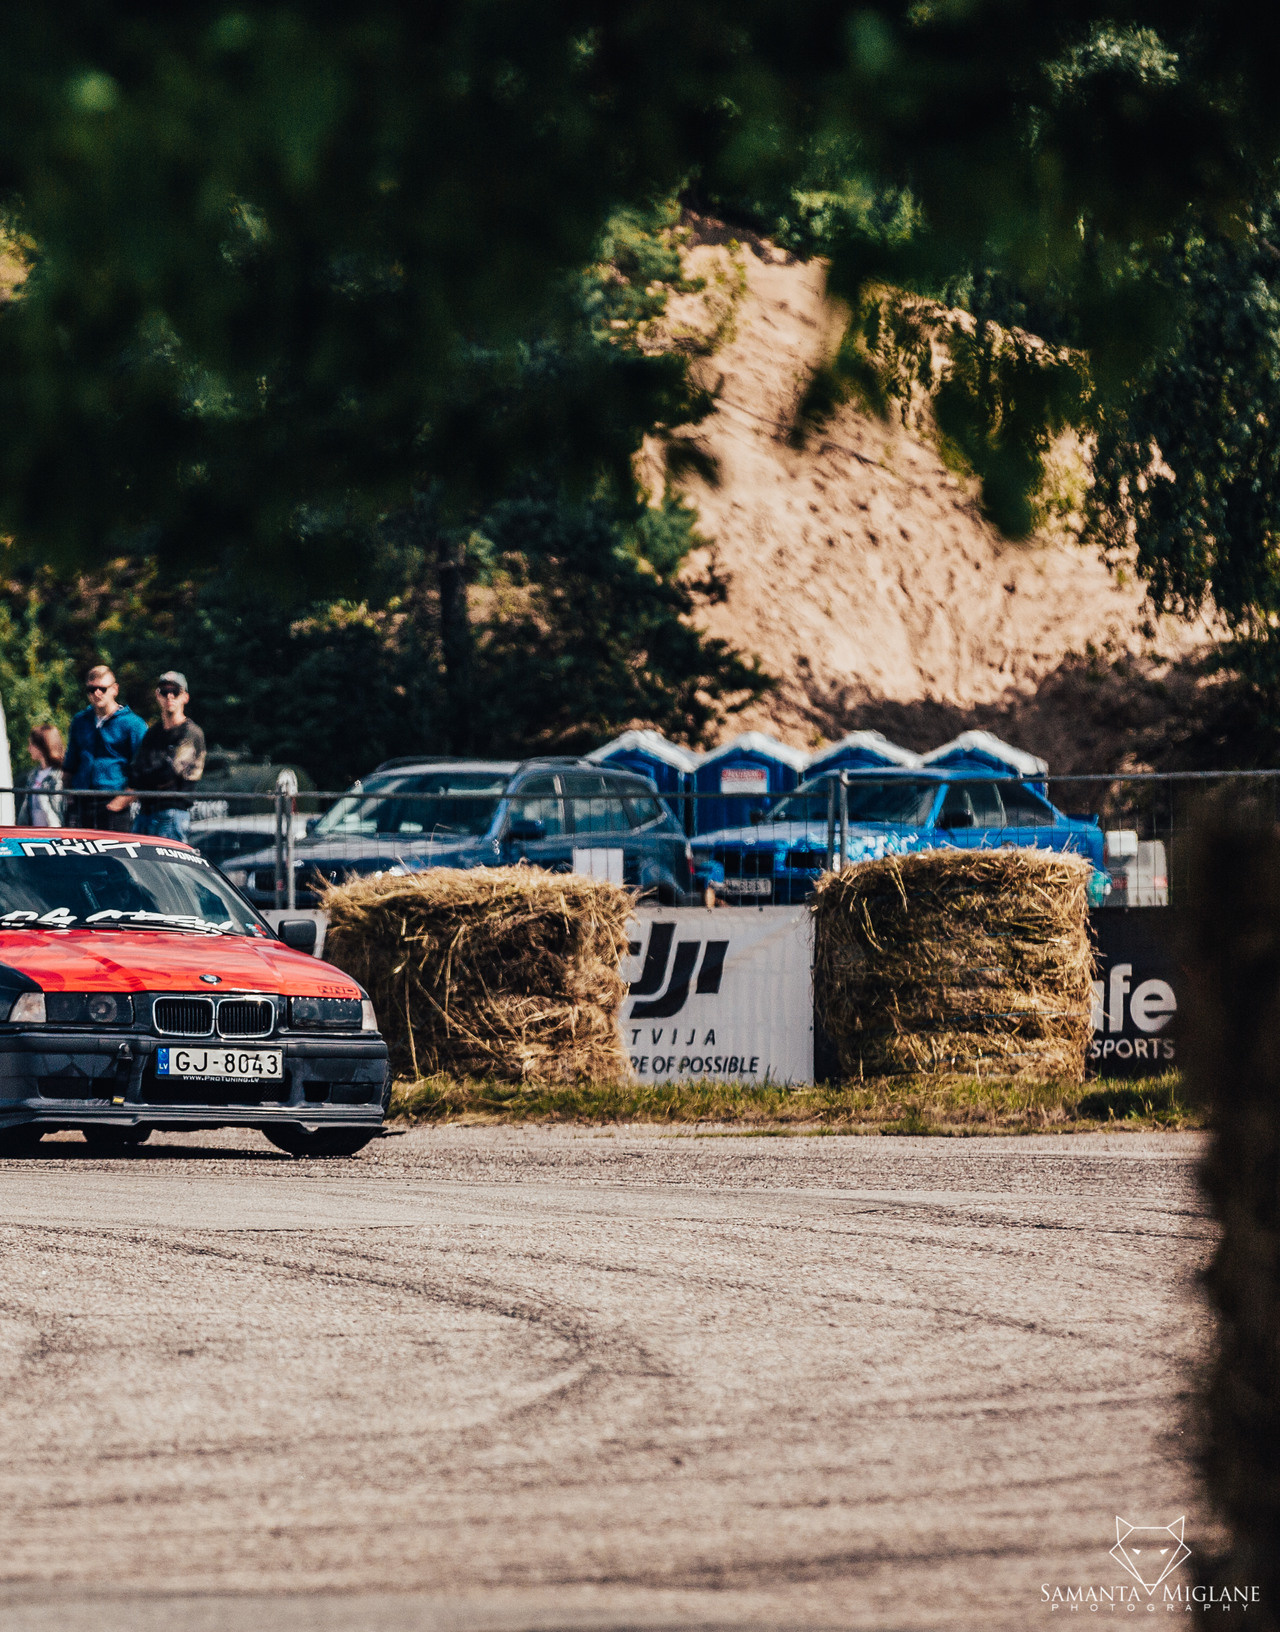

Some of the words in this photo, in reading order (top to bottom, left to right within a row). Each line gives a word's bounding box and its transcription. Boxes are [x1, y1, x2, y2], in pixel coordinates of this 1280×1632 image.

[155, 847, 210, 867] #LVDRIFT
[1090, 1038, 1176, 1059] SPORTS
[175, 1051, 278, 1074] GJ-8043
[652, 1055, 676, 1074] OF
[679, 1055, 760, 1073] POSSIBLE
